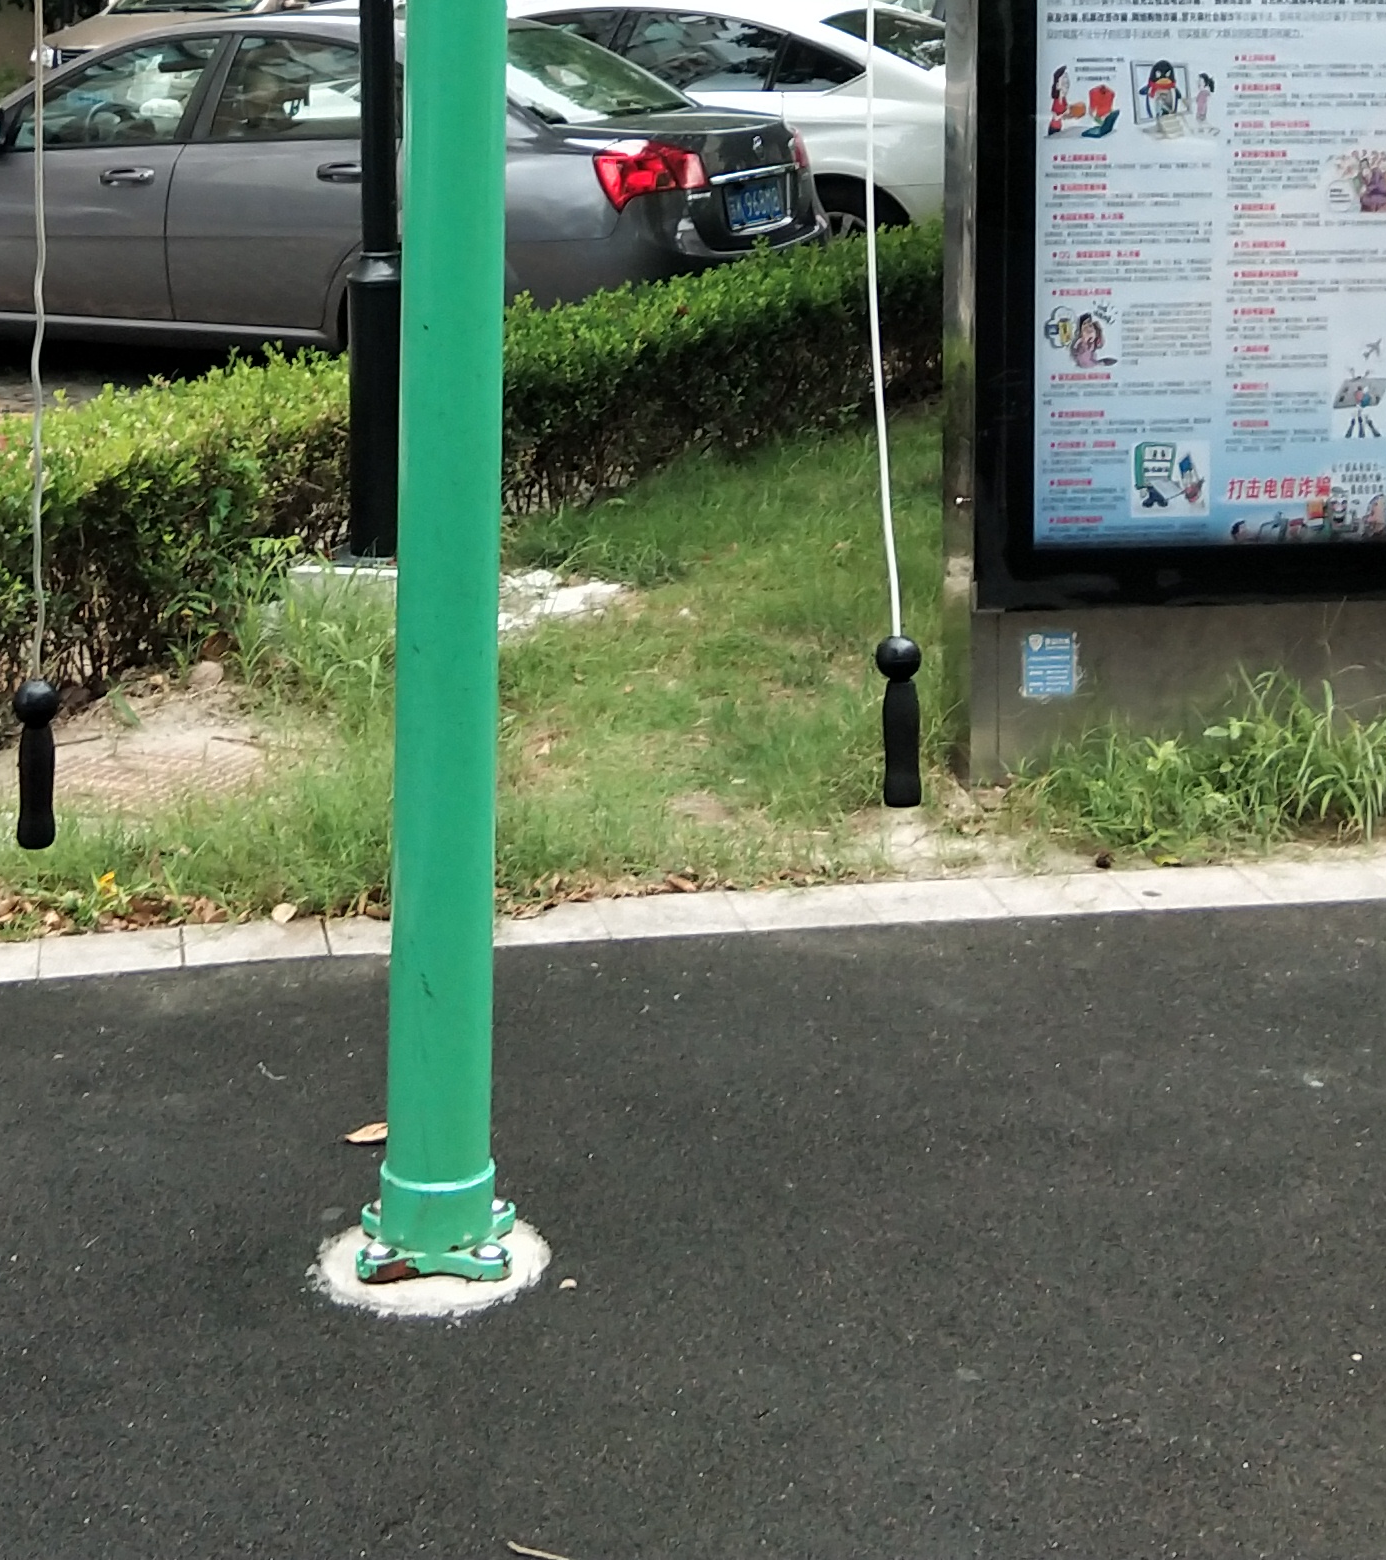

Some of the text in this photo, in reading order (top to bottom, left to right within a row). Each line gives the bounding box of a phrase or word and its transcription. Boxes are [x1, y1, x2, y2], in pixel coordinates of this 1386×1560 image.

[1227, 476, 1332, 500] 打击电信诈骗
